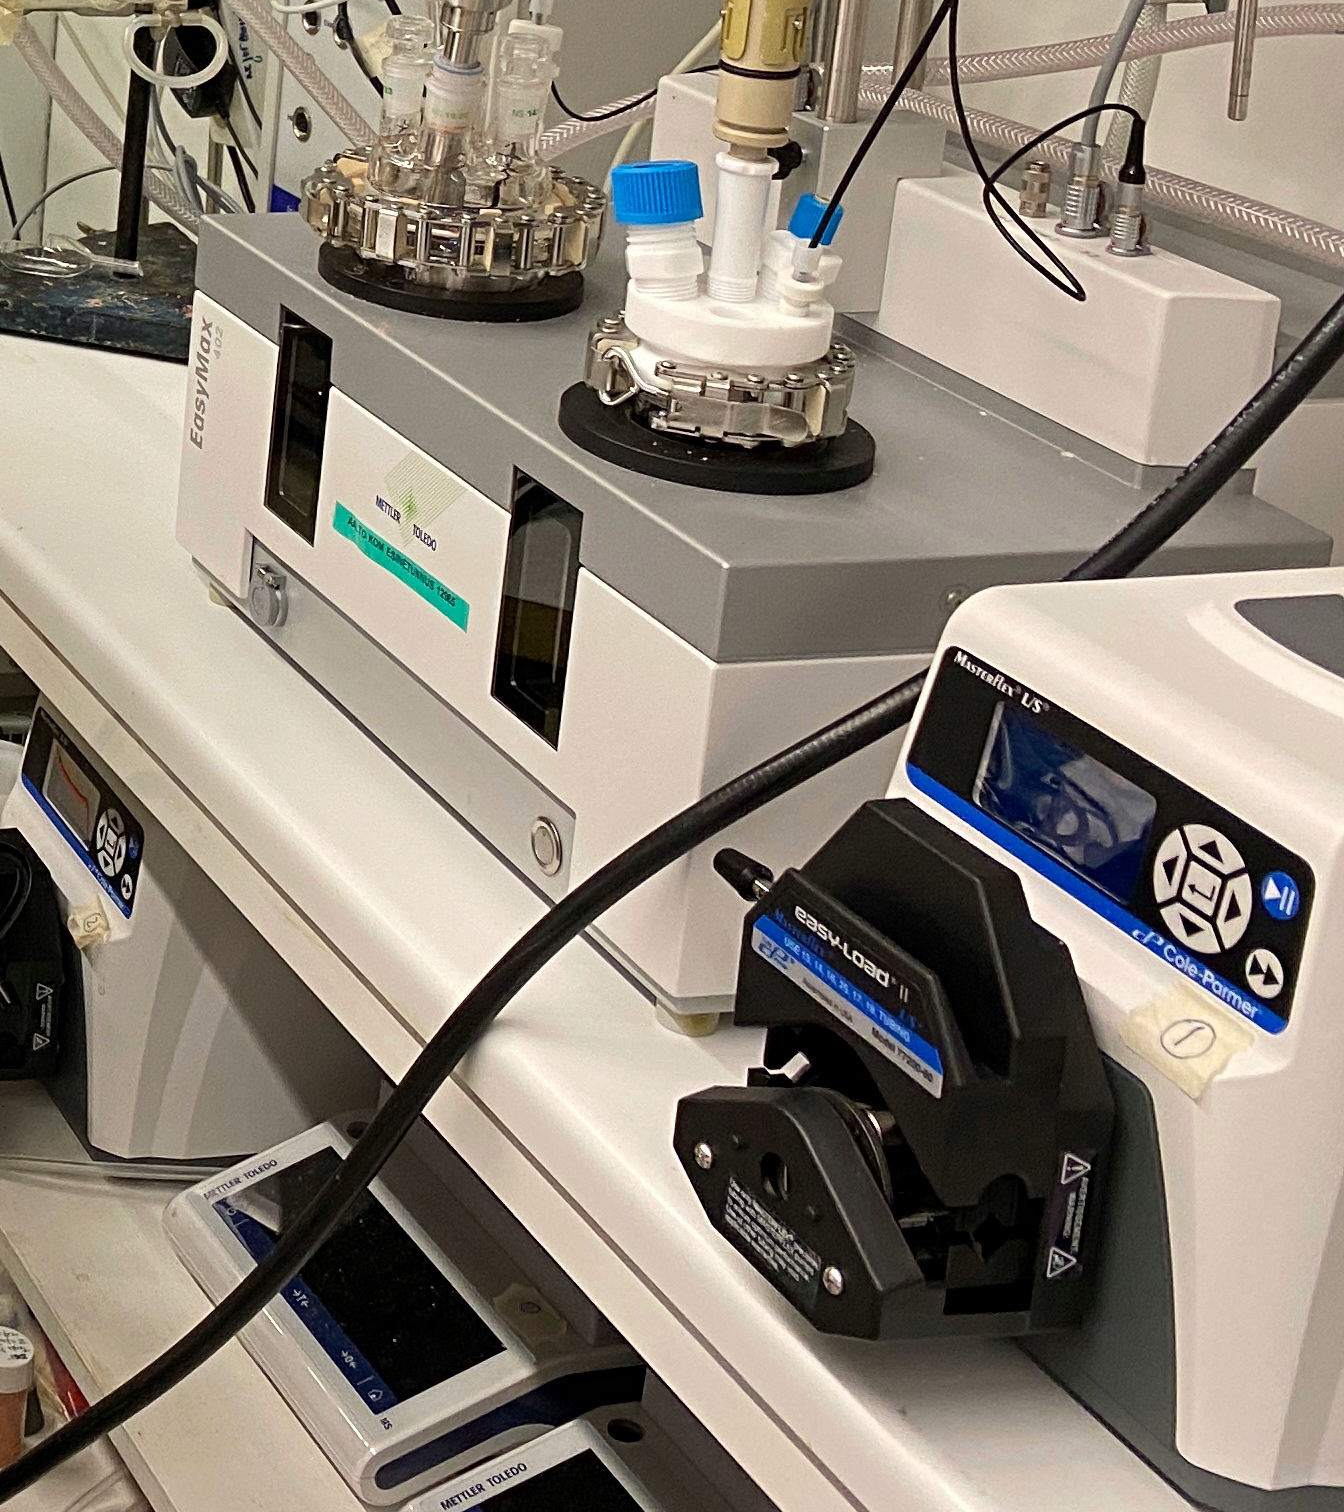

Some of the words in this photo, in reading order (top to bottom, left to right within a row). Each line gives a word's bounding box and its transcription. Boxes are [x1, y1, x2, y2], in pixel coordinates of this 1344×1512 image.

[213, 326, 224, 359] 402
[190, 316, 213, 449] EasyMax
[375, 495, 402, 524] METTLER
[413, 523, 437, 551] TOLEDO
[1163, 945, 1258, 1019] Cole-Parmer
[871, 1026, 896, 1054] Model
[203, 1176, 243, 1202] METTLER
[244, 1158, 279, 1182] TOLEDO
[439, 1482, 486, 1511] METTLER
[486, 1462, 529, 1488] TOLEDO
